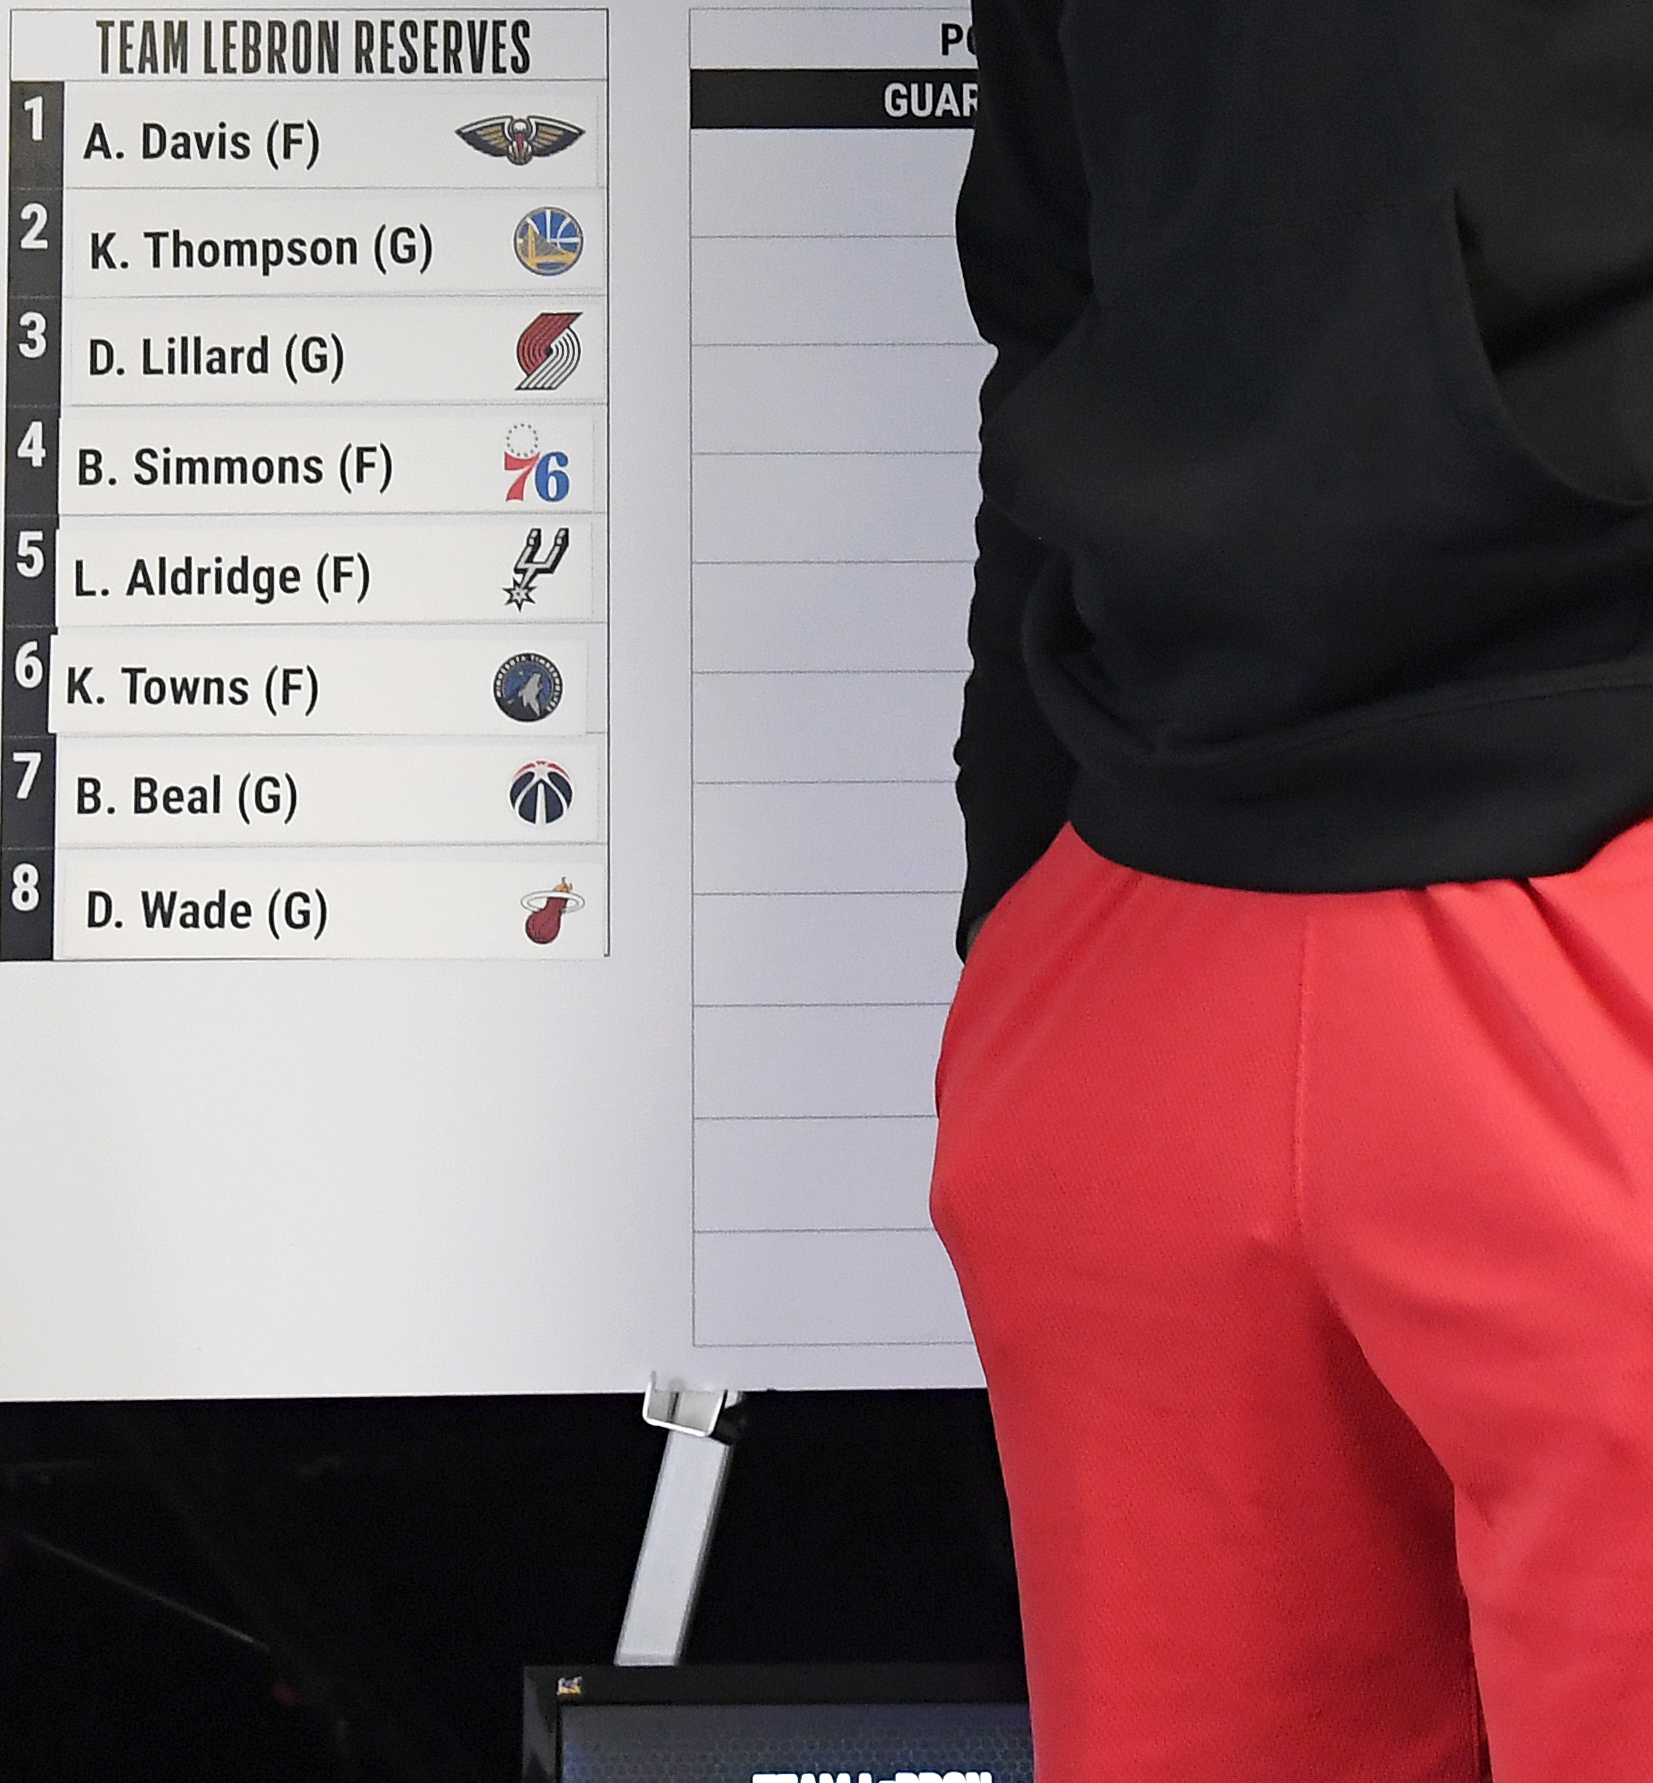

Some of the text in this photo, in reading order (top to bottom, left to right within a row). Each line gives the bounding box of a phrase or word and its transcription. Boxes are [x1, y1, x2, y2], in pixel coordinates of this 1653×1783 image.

[95, 19, 531, 75] TEAM LEBRON RESERVES
[24, 95, 320, 171] 1 A. Davis (F)
[20, 202, 433, 277] 2 K. Thompson (G)
[18, 311, 344, 385] 3 D. Lillard (G)
[17, 420, 393, 494] 4 B. Simmons (F)
[504, 450, 571, 503] 76
[16, 530, 370, 605] 5 L. Aldridge (F)
[15, 640, 318, 717] 6 K. Towns (F)
[12, 752, 297, 825] 7 B. Beal (G)
[11, 863, 327, 941] 8 D. Wade (G)
